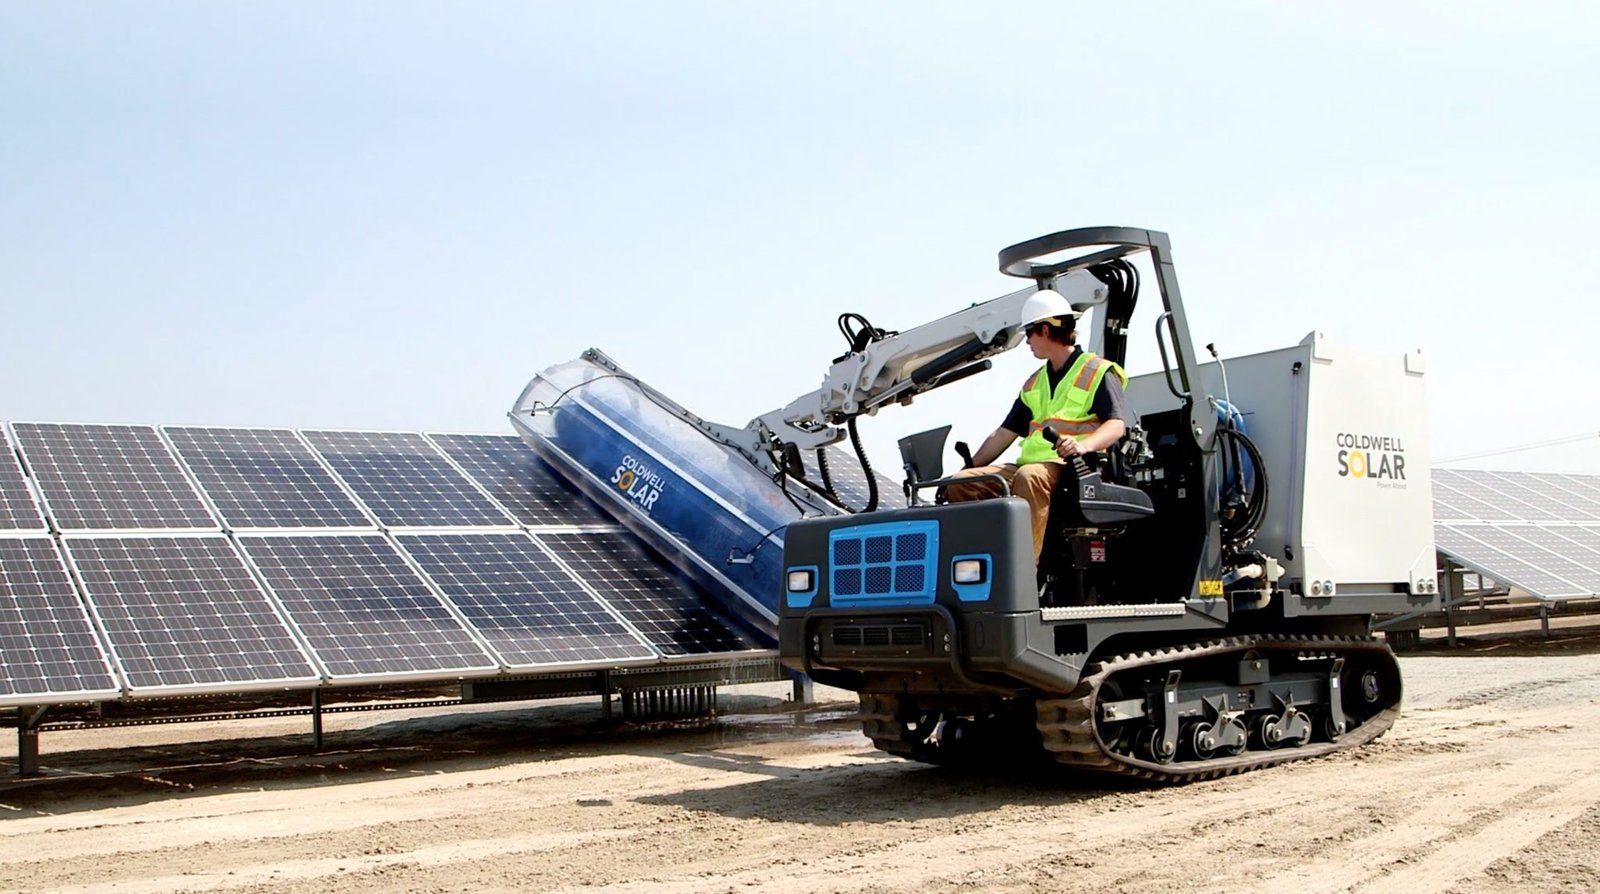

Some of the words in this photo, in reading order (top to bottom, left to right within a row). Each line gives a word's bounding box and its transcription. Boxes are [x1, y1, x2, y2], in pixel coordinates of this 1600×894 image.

[1336, 432, 1404, 452] COLDWELL
[622, 455, 665, 492] COLDWELL
[1337, 449, 1406, 480] SOLAR
[610, 465, 660, 510] SOLAR
